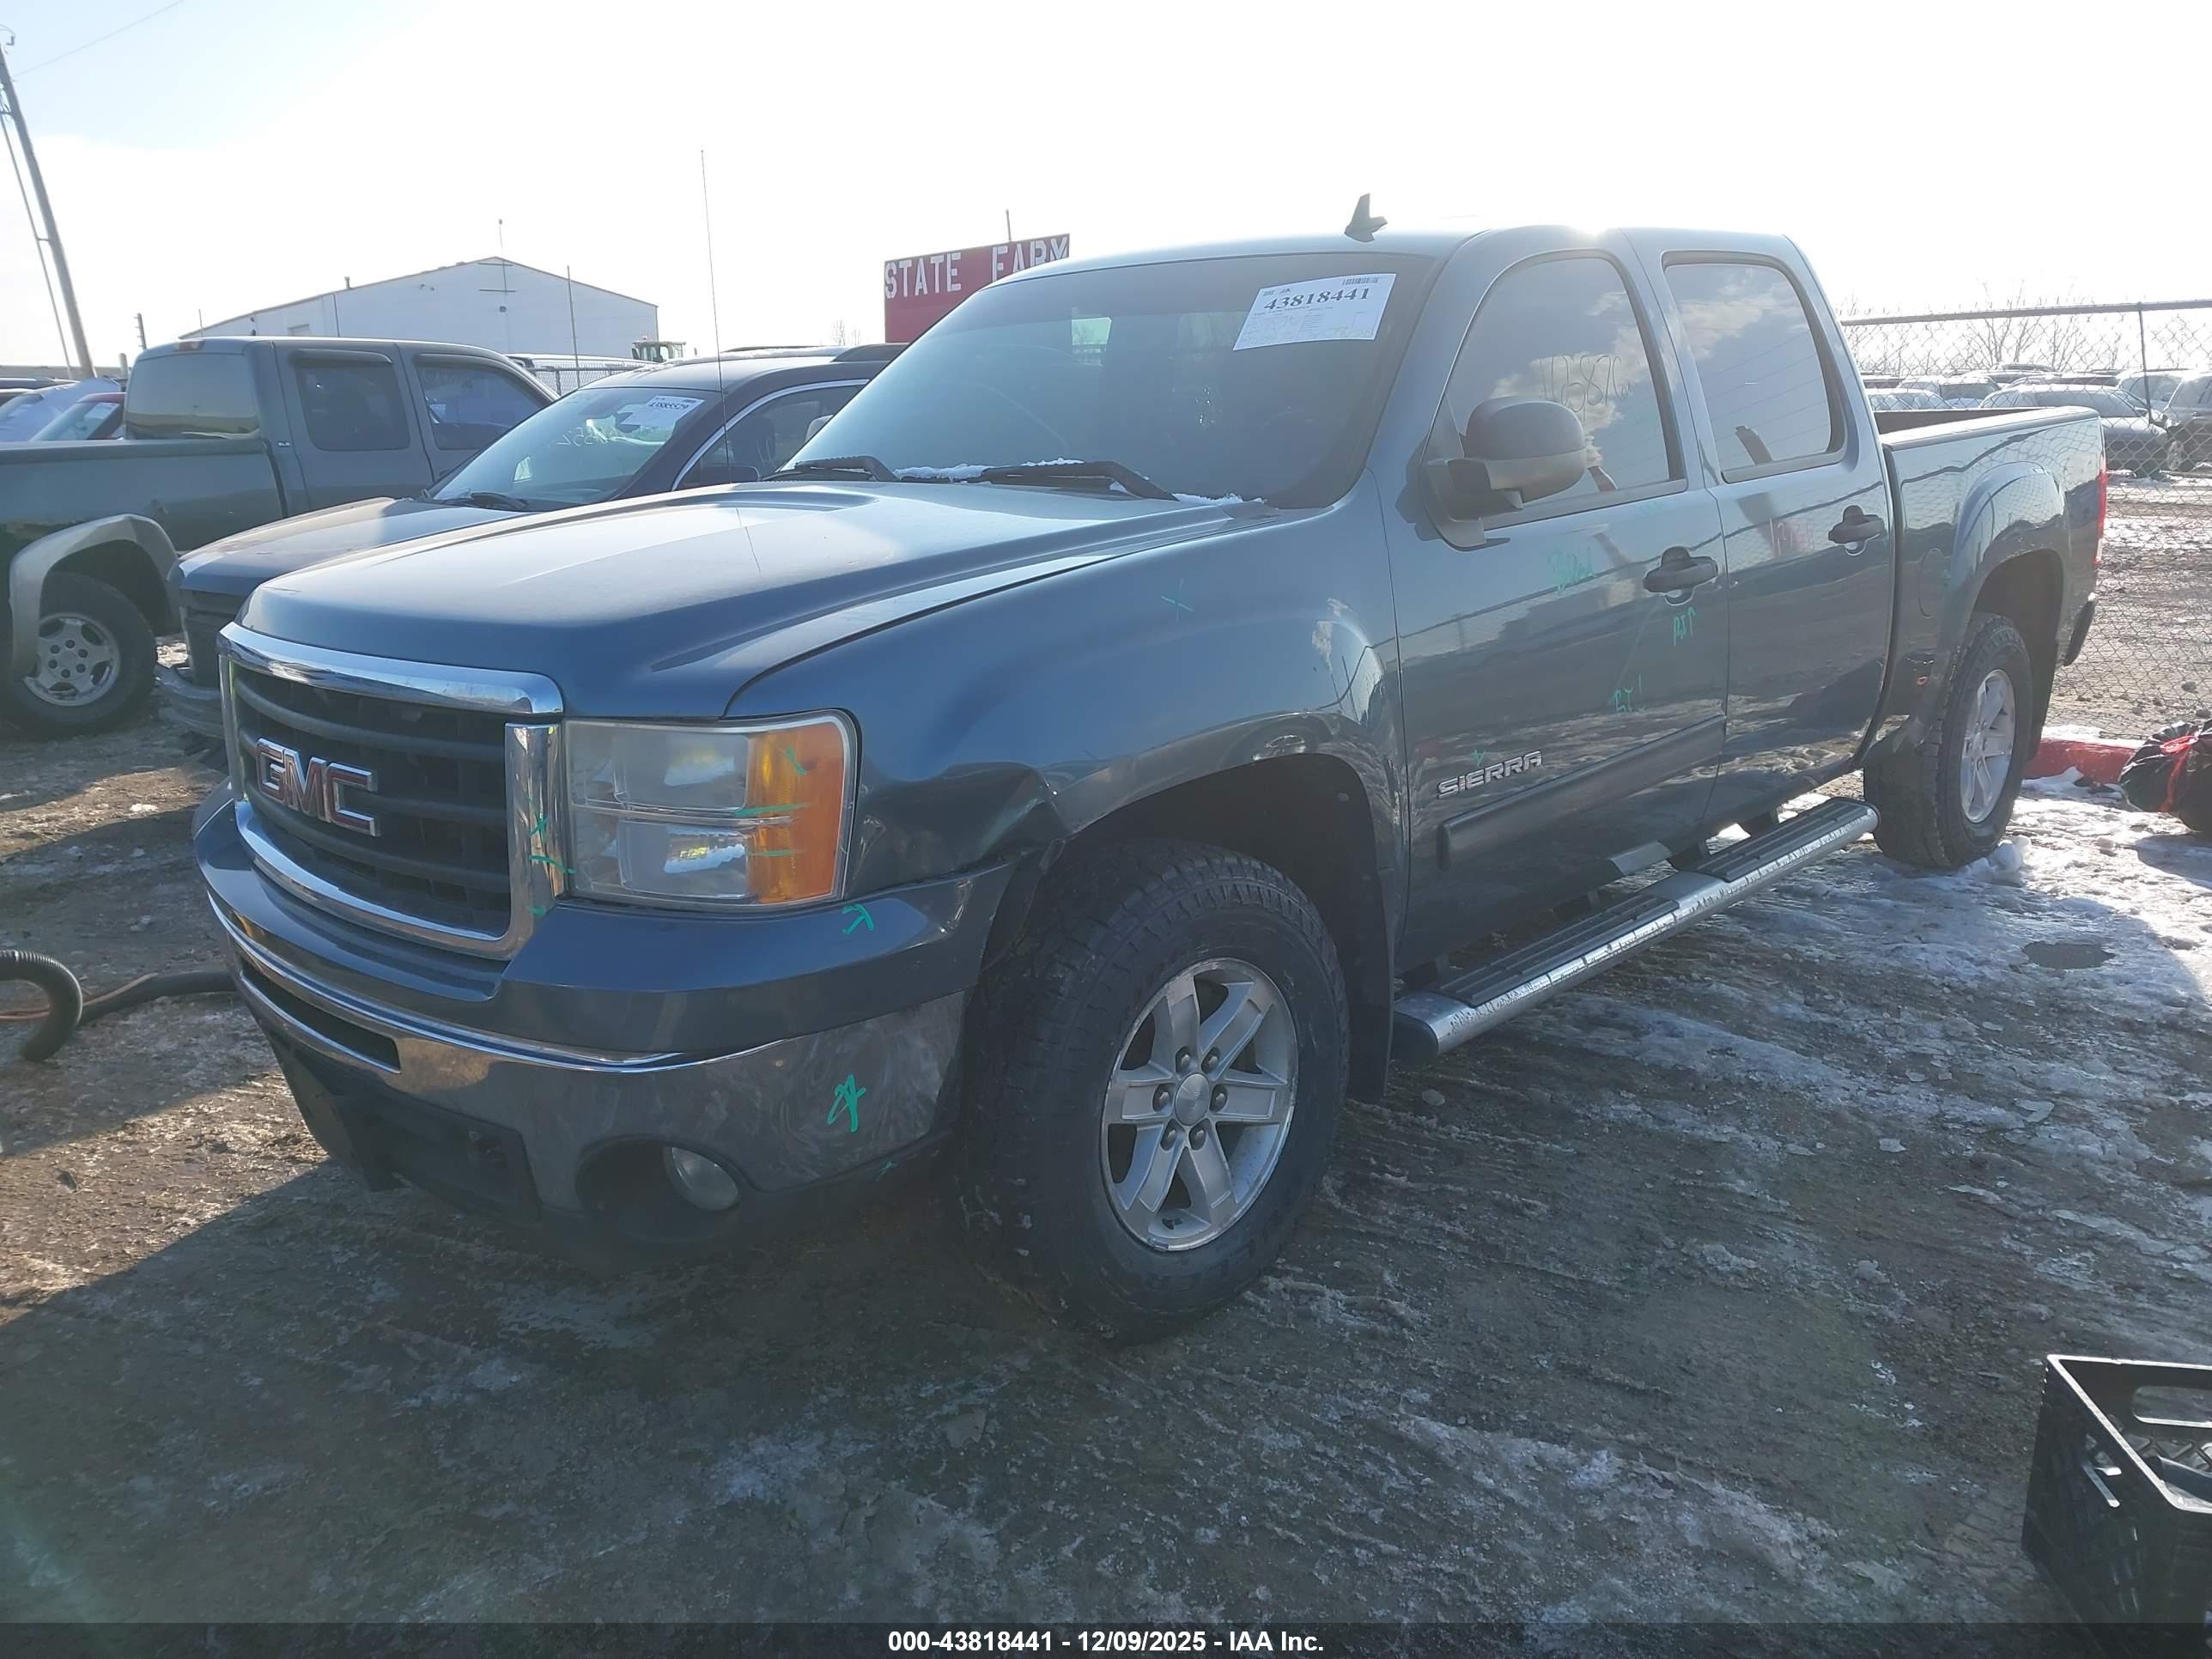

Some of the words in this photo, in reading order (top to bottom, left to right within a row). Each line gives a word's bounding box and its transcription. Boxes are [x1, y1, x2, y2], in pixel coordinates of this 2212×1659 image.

[884, 252, 962, 300] STATE
[1264, 288, 1370, 311] 43818441
[257, 738, 380, 837] GMC
[1437, 750, 1543, 799] SIERRA
